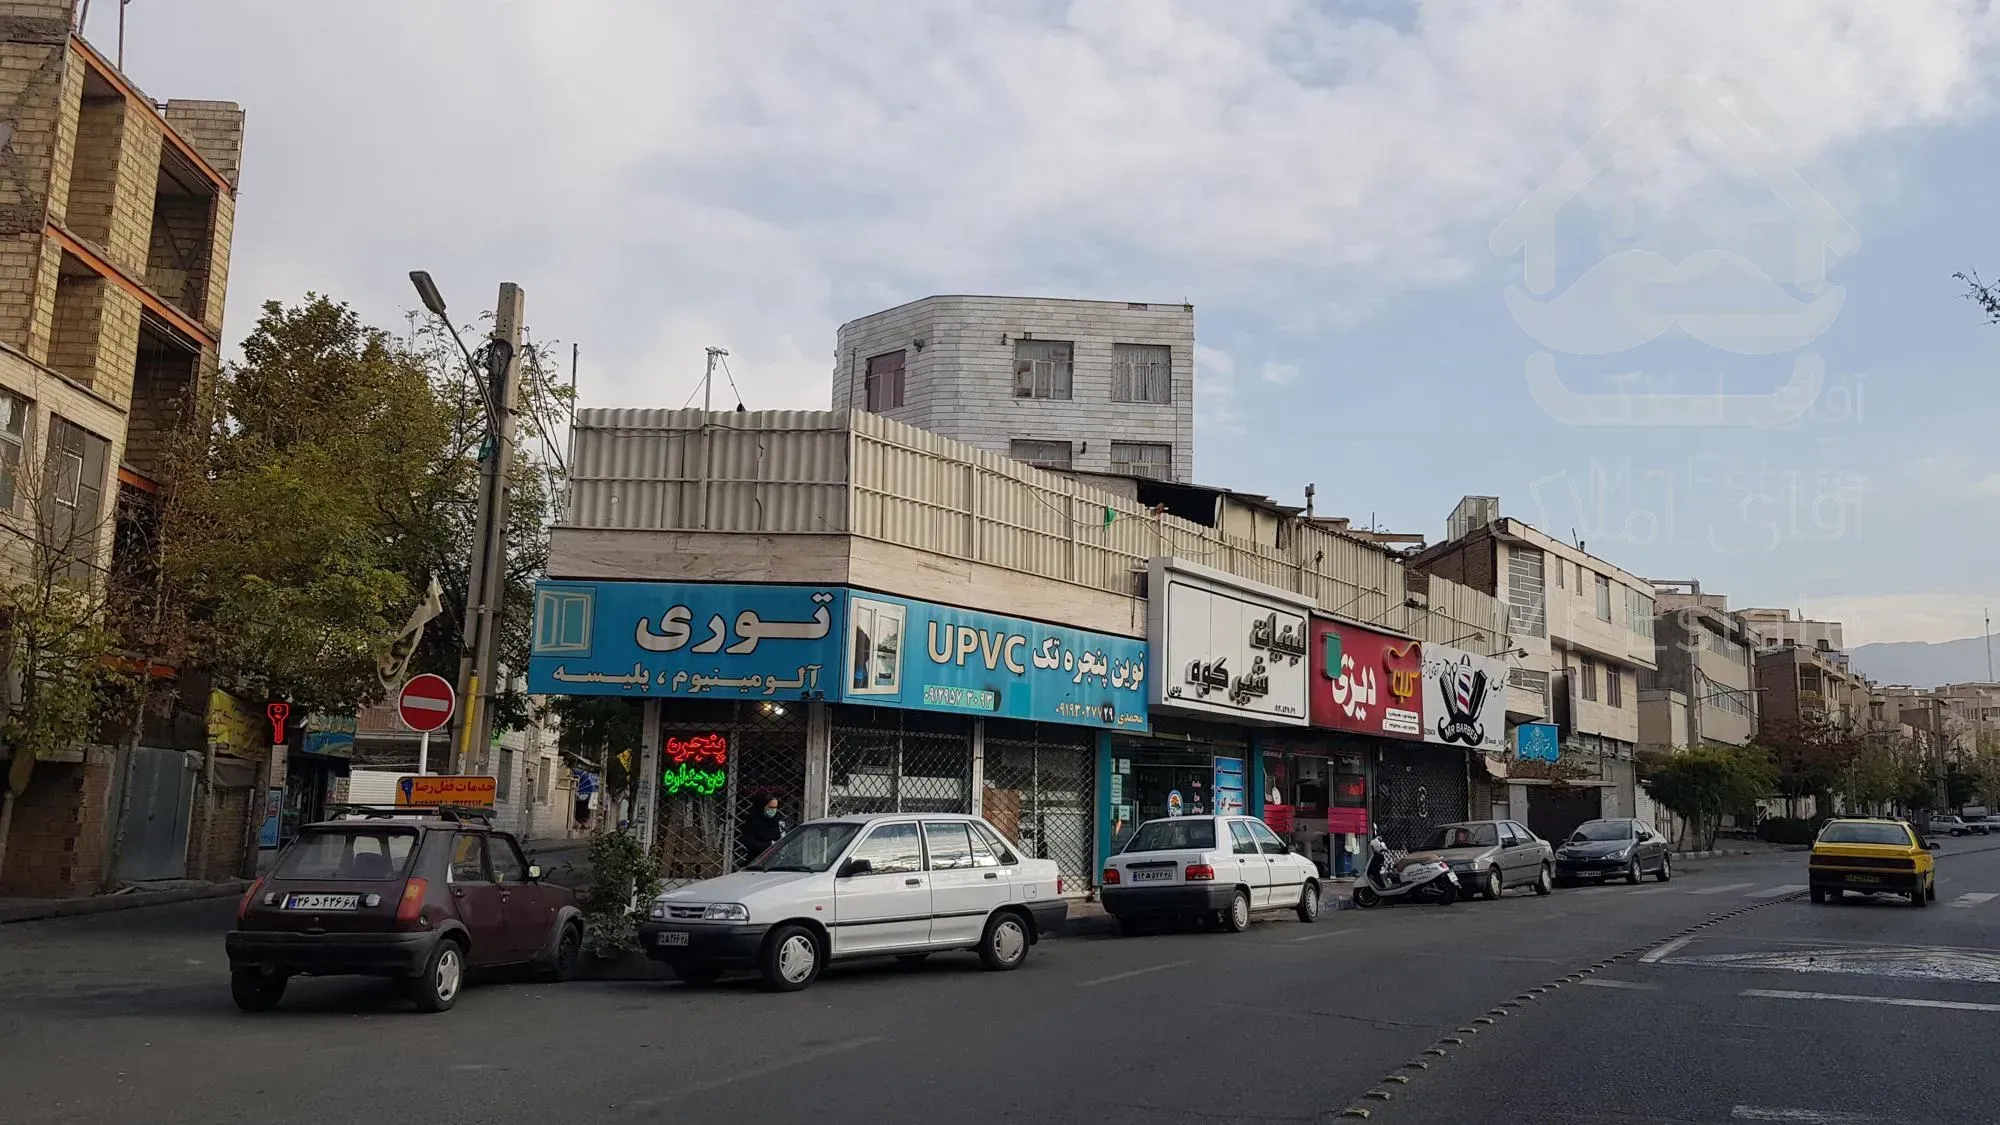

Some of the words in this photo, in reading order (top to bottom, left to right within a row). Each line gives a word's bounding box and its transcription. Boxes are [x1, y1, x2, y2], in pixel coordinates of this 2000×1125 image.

[634, 591, 836, 655] توری
[1249, 612, 1307, 668] لبنیات
[926, 620, 1027, 676] UPVC
[1031, 637, 1062, 671] تک
[1063, 648, 1109, 687] پنجره
[551, 662, 650, 692] پلیسه
[1110, 651, 1146, 691] نوین
[1331, 653, 1377, 721] دیزی
[666, 734, 727, 765] پنجره
[1444, 724, 1456, 740] MR
[1455, 722, 1479, 744] BARBER
